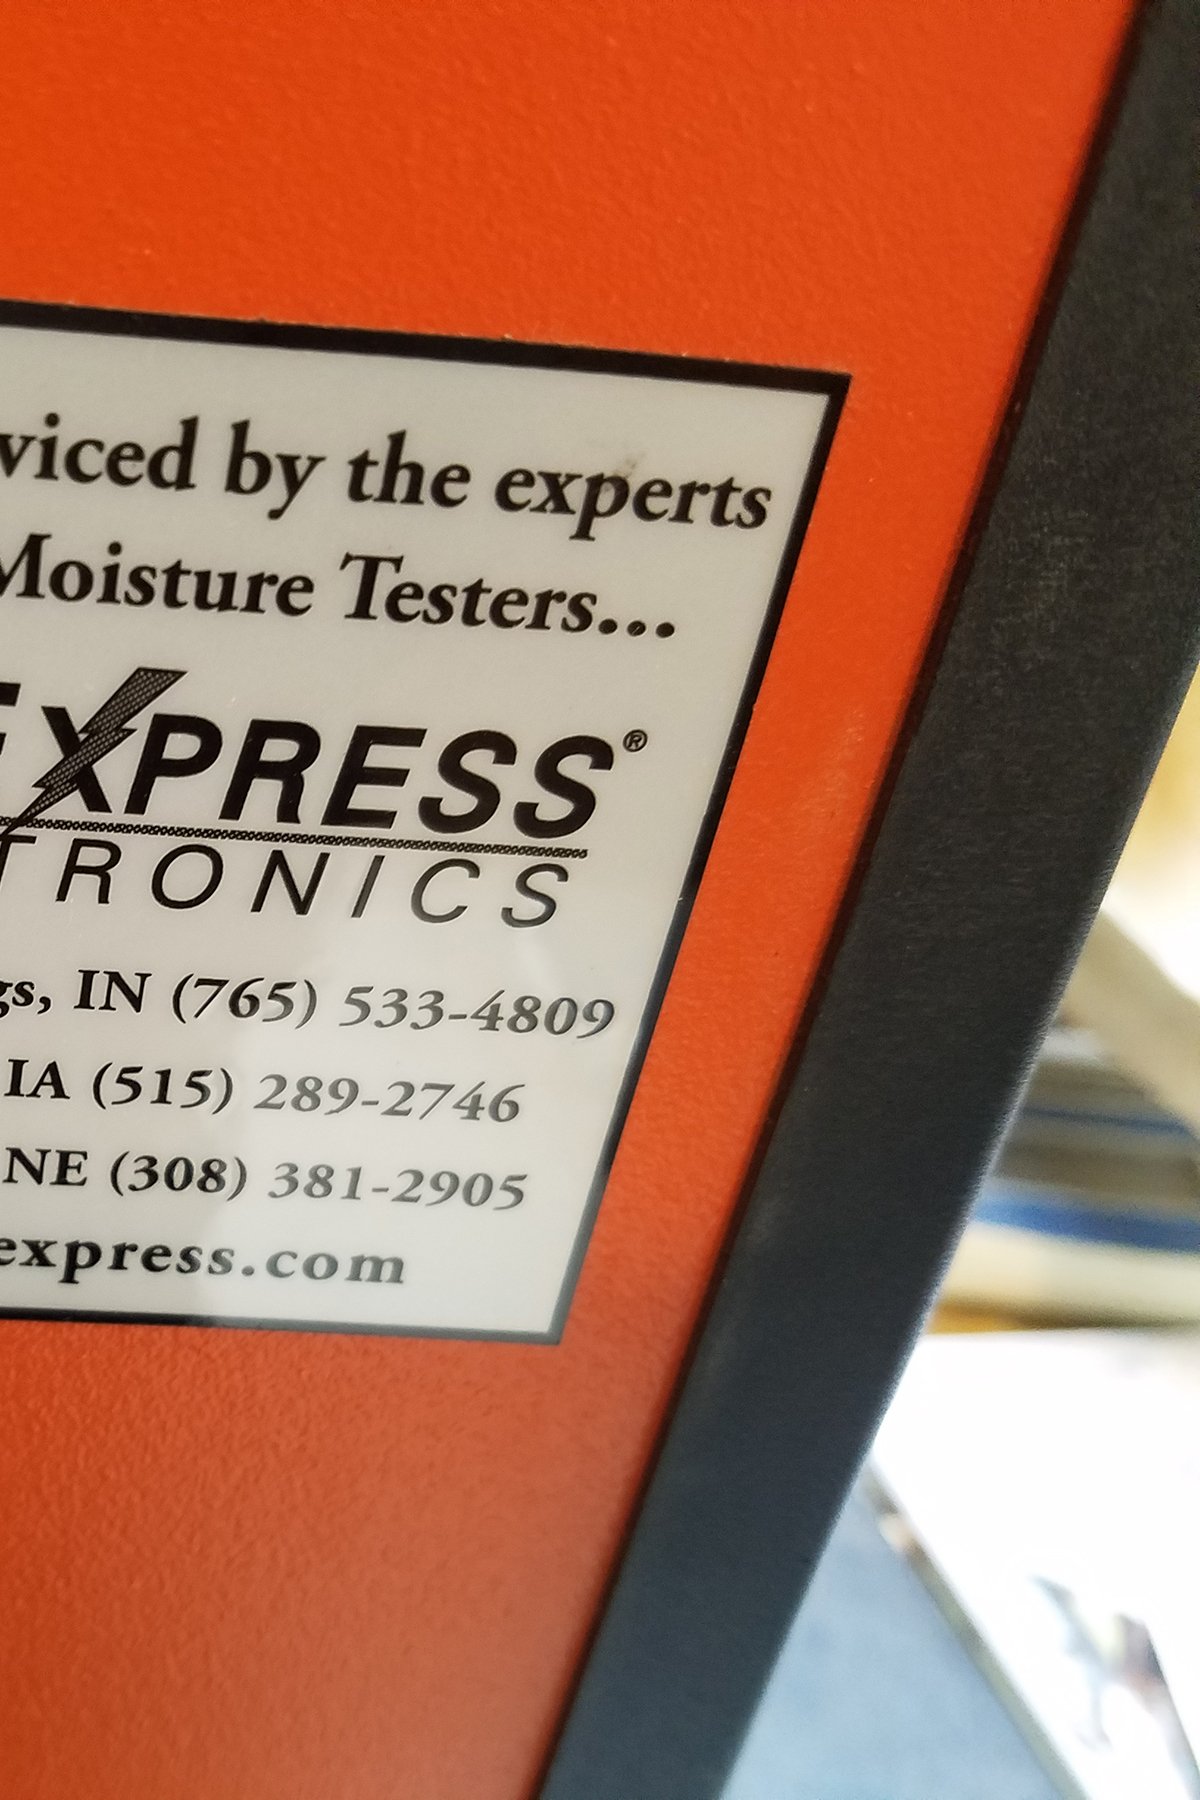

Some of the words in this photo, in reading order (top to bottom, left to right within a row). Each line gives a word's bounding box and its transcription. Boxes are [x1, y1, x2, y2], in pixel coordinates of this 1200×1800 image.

[224, 418, 328, 522] by
[347, 428, 473, 510] the
[494, 466, 772, 542] experts
[339, 551, 677, 640] Testers...
[73, 969, 153, 1015] IN
[171, 972, 318, 1030] (765)
[337, 985, 615, 1039] 533-4809
[3, 1058, 71, 1100] IA
[92, 1061, 234, 1115] (515)
[253, 1073, 526, 1123] 289-2746
[1, 1146, 89, 1188] NE
[108, 1150, 248, 1202] (308)
[267, 1162, 528, 1211] 381-2905
